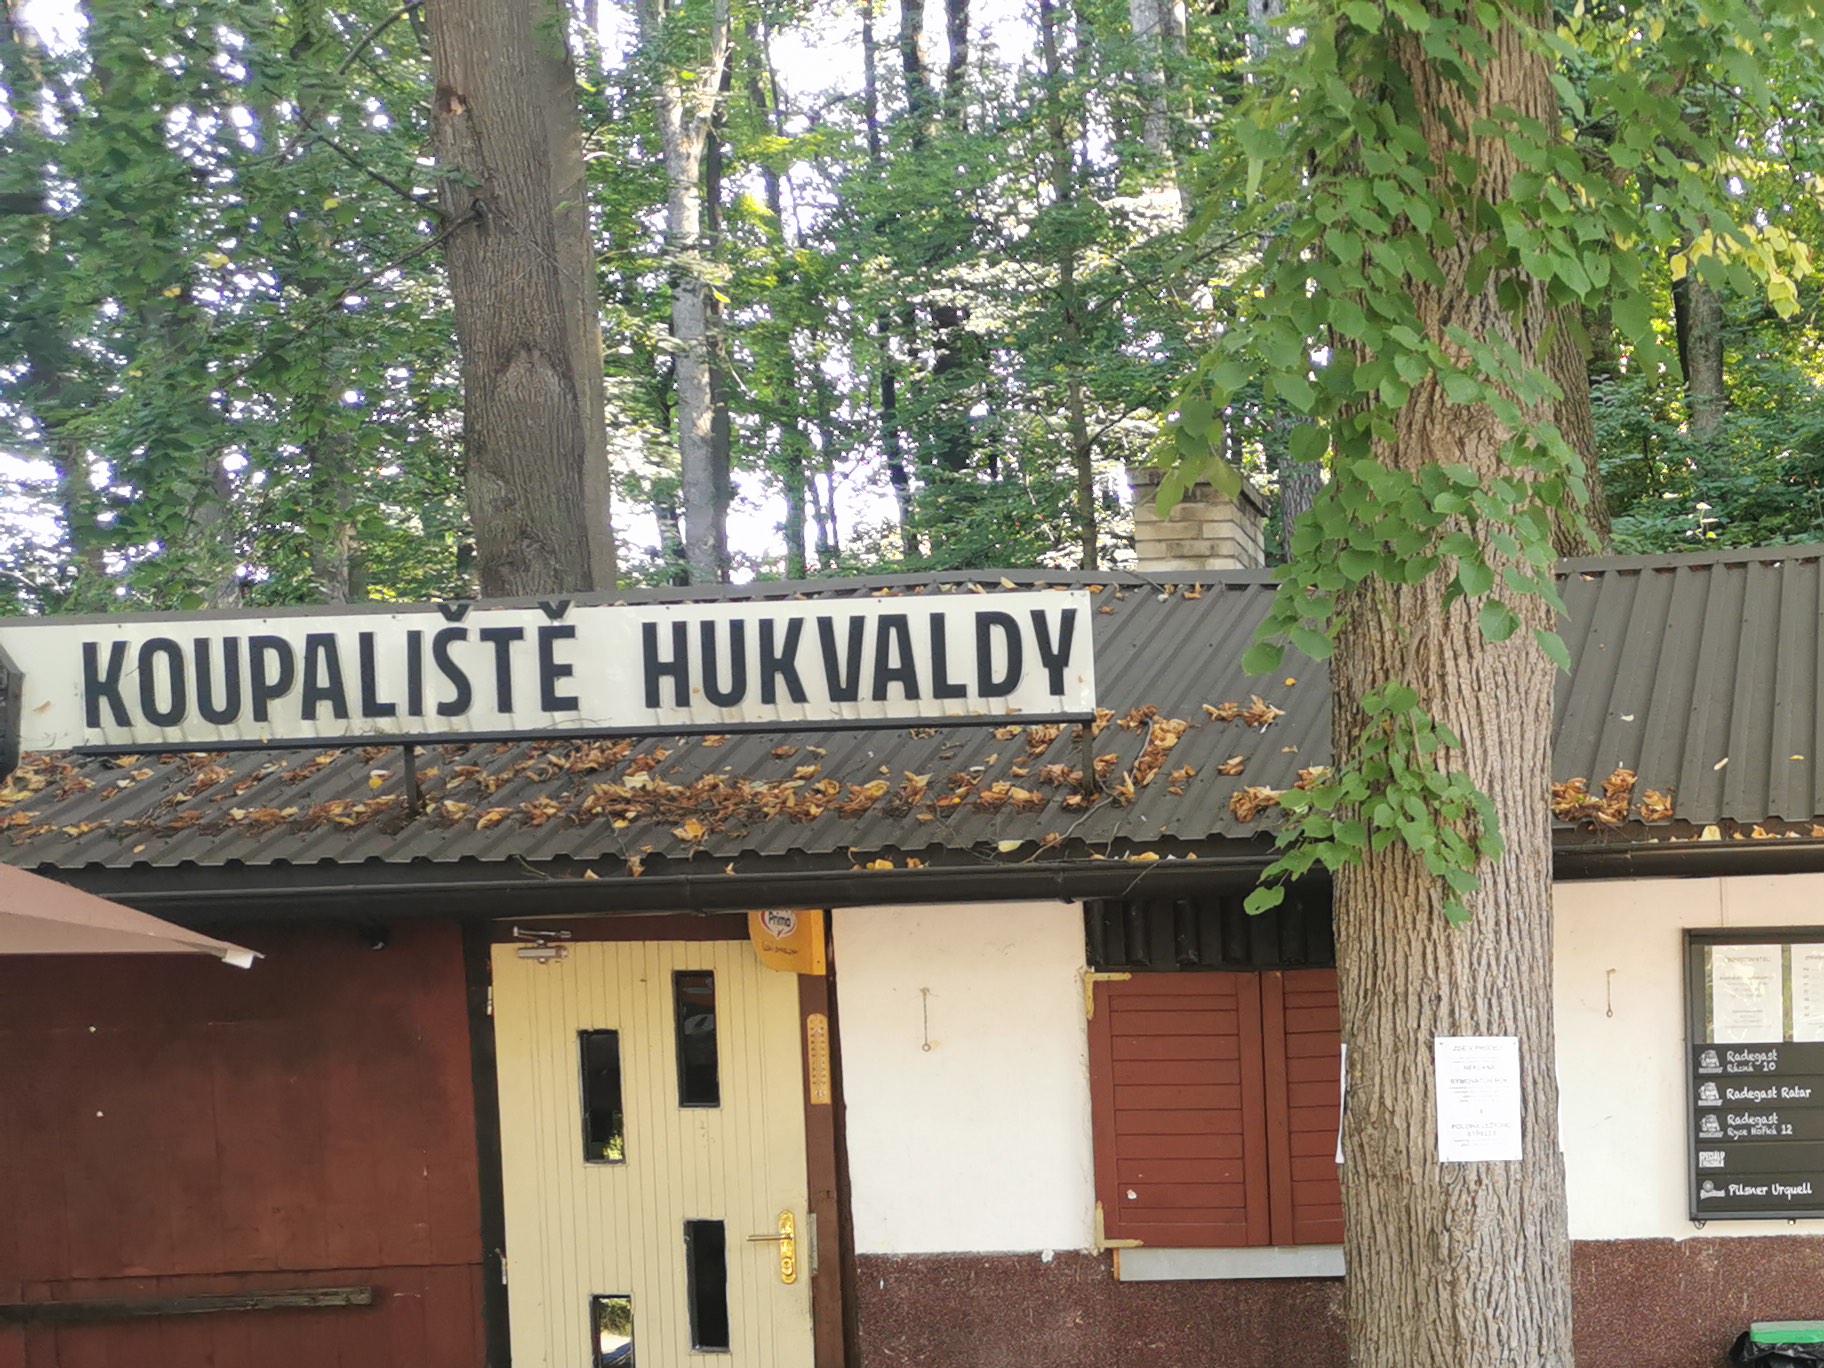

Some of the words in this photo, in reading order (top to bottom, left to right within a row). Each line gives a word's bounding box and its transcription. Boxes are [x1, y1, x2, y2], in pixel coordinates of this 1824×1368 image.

[82, 601, 579, 728] KOUPALIŠTĚ
[641, 609, 1077, 708] HUKVALDY
[1726, 1049, 1778, 1065] Radegast
[1762, 1061, 1776, 1072] 10
[1726, 1086, 1778, 1103] Radegast
[1727, 1112, 1778, 1128] Radegast
[1781, 1124, 1793, 1135] 12
[1728, 1184, 1768, 1196] Pilsner
[1772, 1182, 1812, 1201] Urquell
